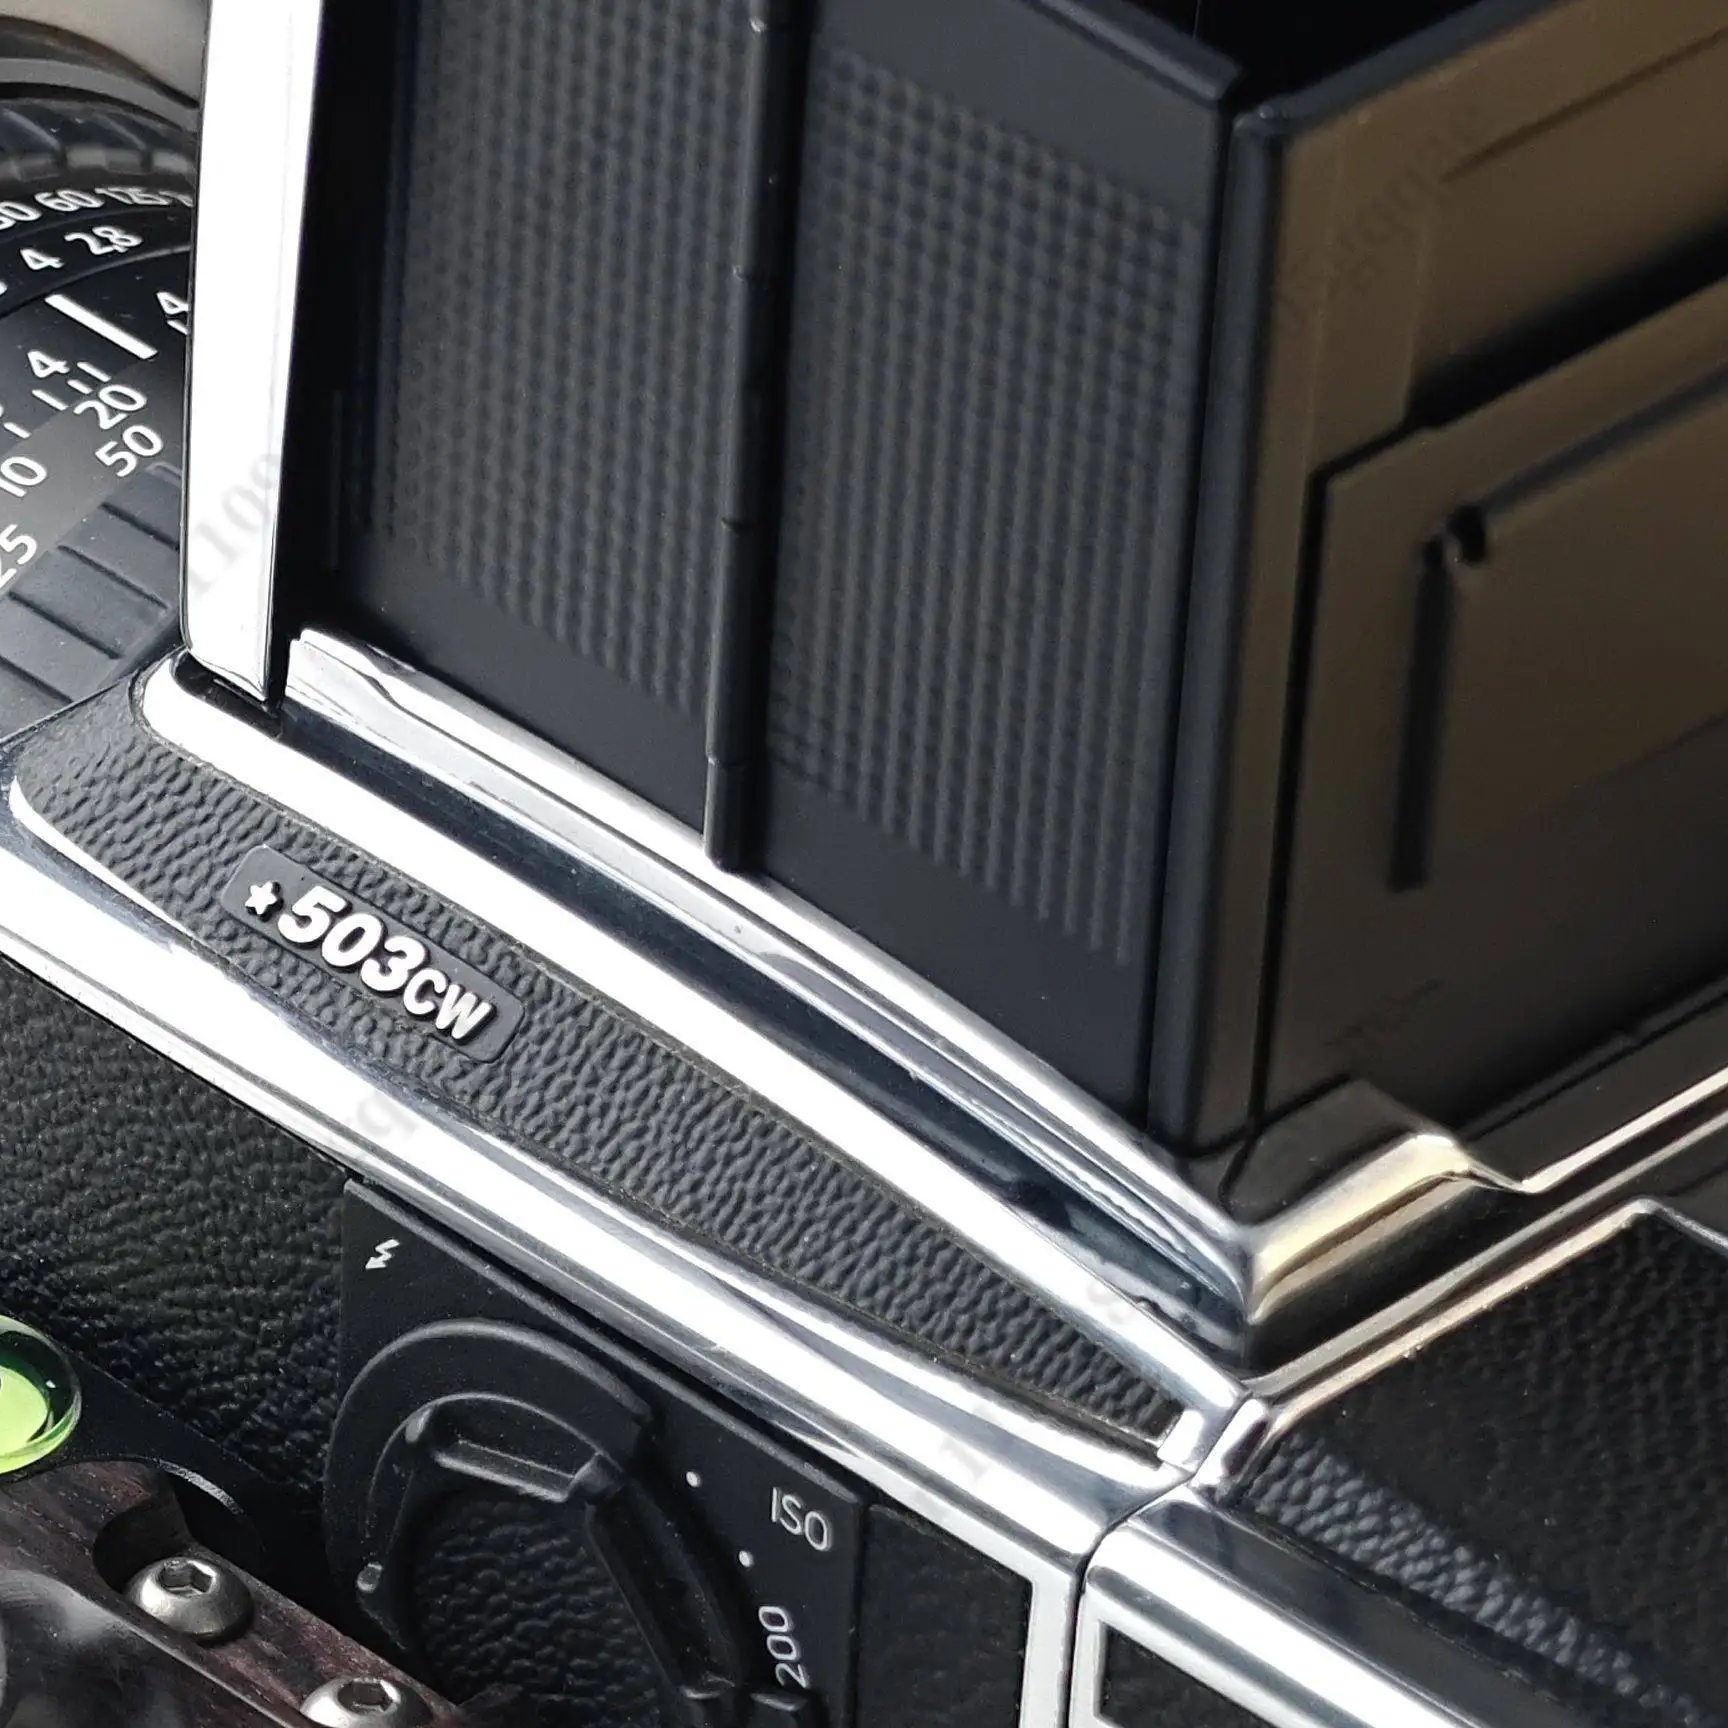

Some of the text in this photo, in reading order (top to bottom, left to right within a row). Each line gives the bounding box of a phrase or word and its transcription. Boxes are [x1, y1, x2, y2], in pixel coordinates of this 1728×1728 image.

[34, 189, 105, 212] 60
[20, 247, 65, 271] 4
[27, 350, 70, 378] 4
[73, 383, 148, 430] 20
[94, 424, 164, 478] 50
[276, 884, 496, 1043] 503CW
[771, 1486, 833, 1551] ISO
[758, 1605, 812, 1689] 200
